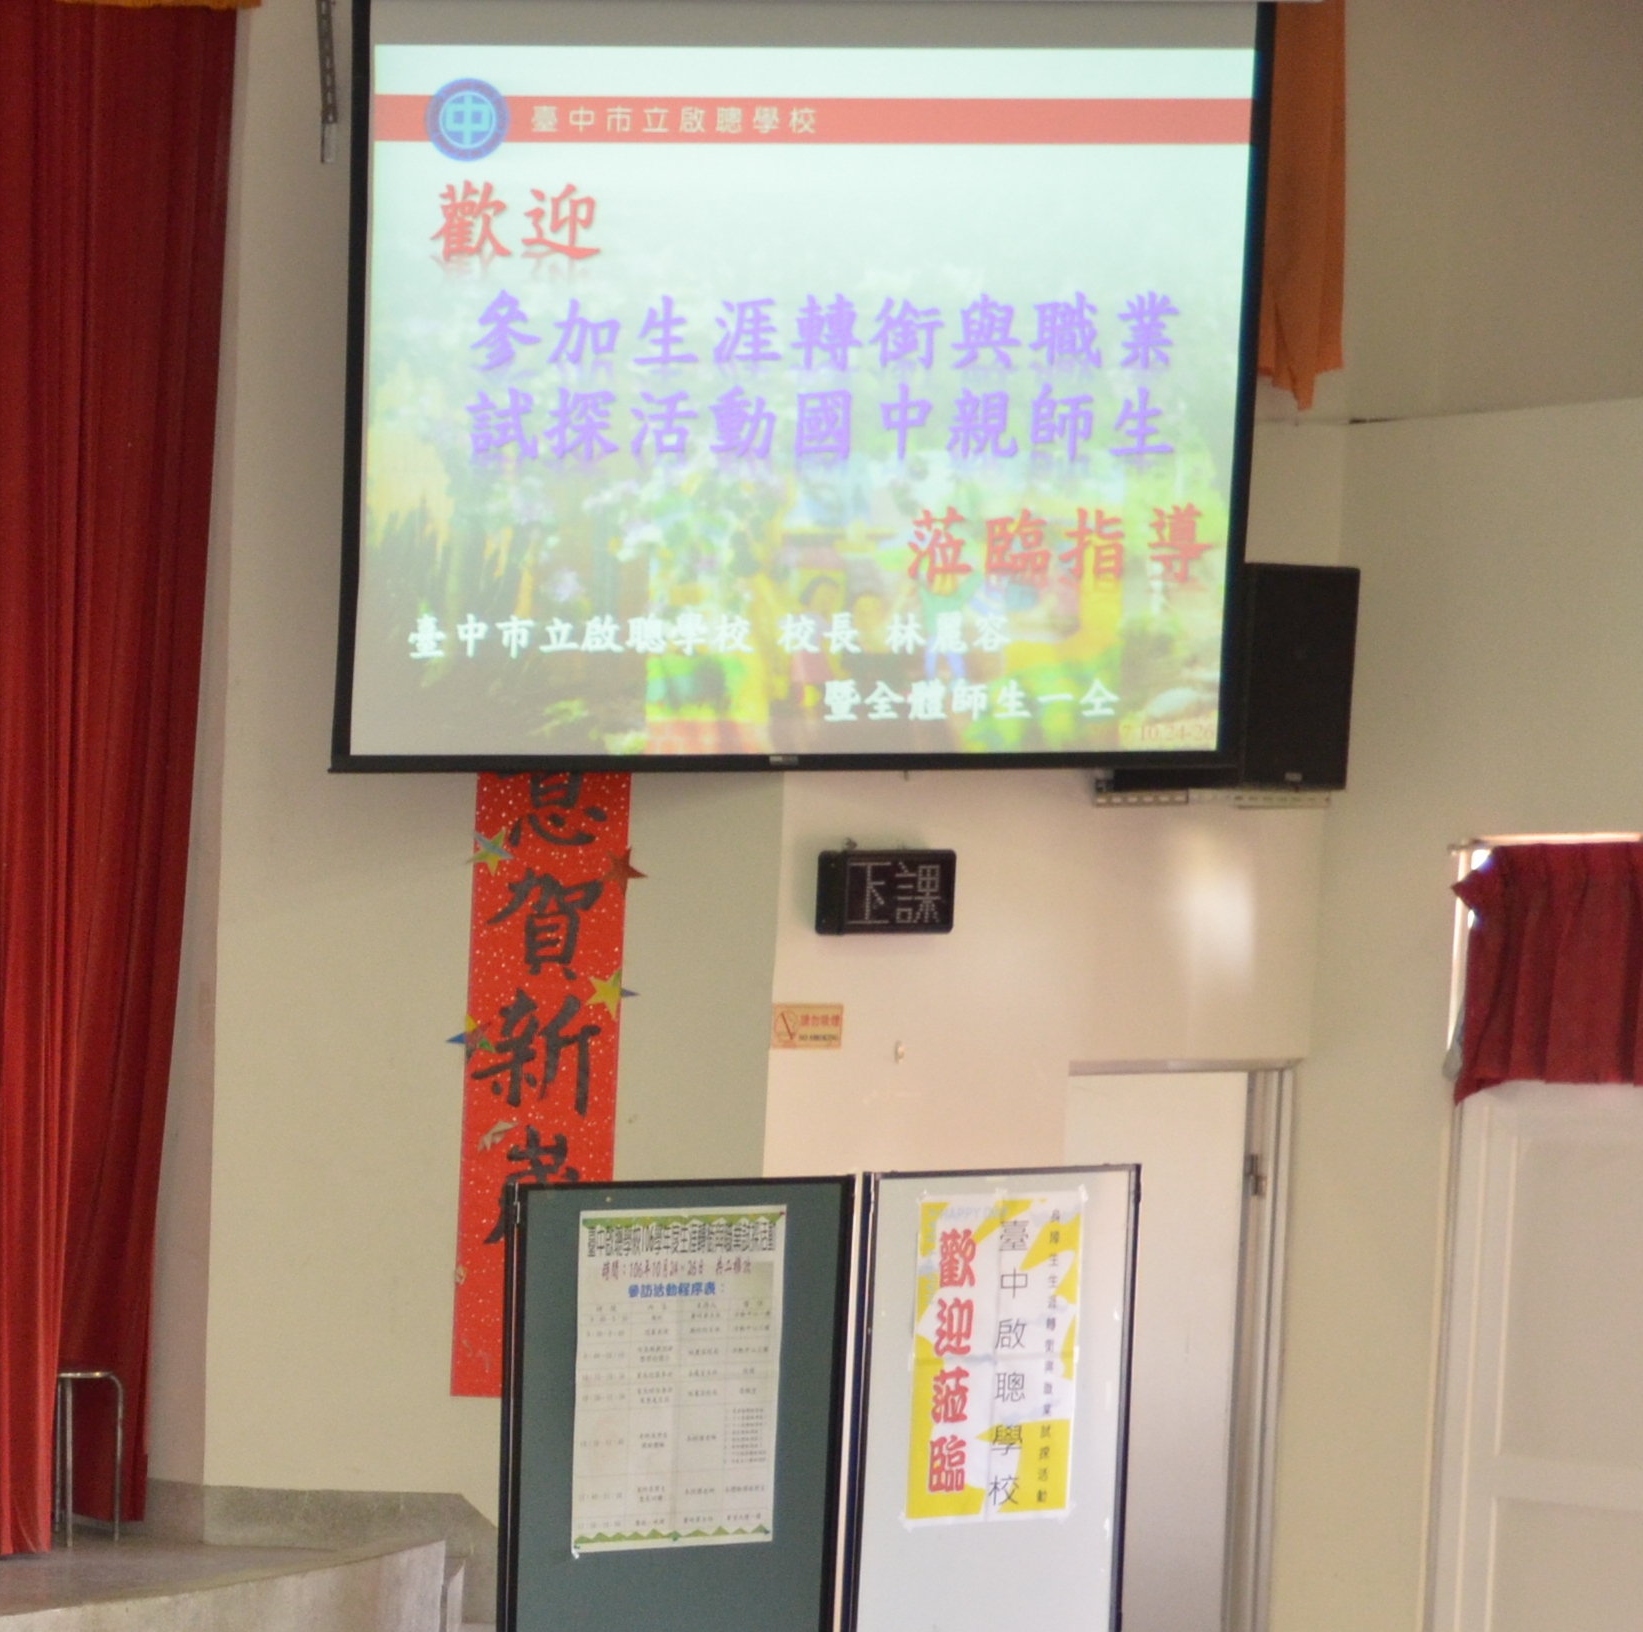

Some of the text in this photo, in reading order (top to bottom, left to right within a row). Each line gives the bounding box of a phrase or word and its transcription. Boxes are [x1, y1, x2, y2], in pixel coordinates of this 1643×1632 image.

[530, 104, 817, 134] 臺中市立啟聰學校
[429, 179, 602, 262] 歡迎
[469, 289, 1181, 372] 參加生涯轉銜與職業
[466, 383, 1177, 462] 試探活動國中親師生
[906, 504, 1215, 586] 蒞臨指導
[777, 612, 861, 655] 校長
[927, 1228, 978, 1494] 歡迎蒞臨
[988, 1219, 1030, 1507] 臺中啟聰學校
